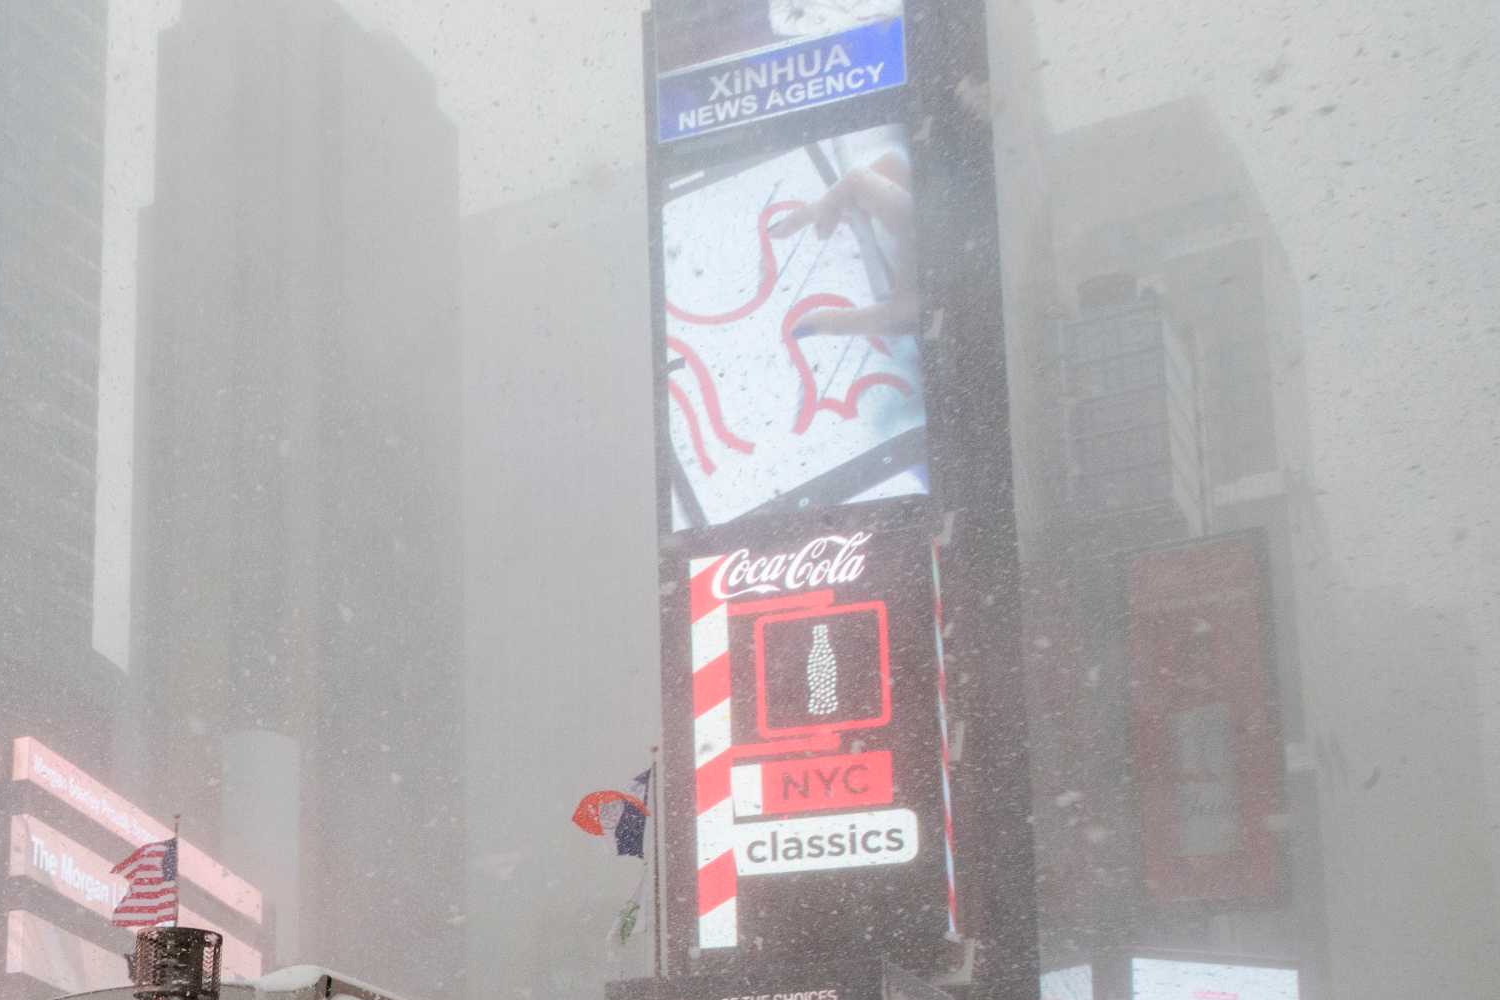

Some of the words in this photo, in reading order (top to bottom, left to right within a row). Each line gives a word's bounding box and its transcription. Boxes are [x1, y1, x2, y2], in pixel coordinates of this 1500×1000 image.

[678, 96, 758, 131] NEWS
[766, 62, 884, 109] AGENCY
[712, 531, 872, 599] Coca-Cola
[781, 764, 870, 800] NYC
[31, 833, 59, 877] The
[61, 853, 111, 907] Morgan
[746, 823, 904, 863] classics
